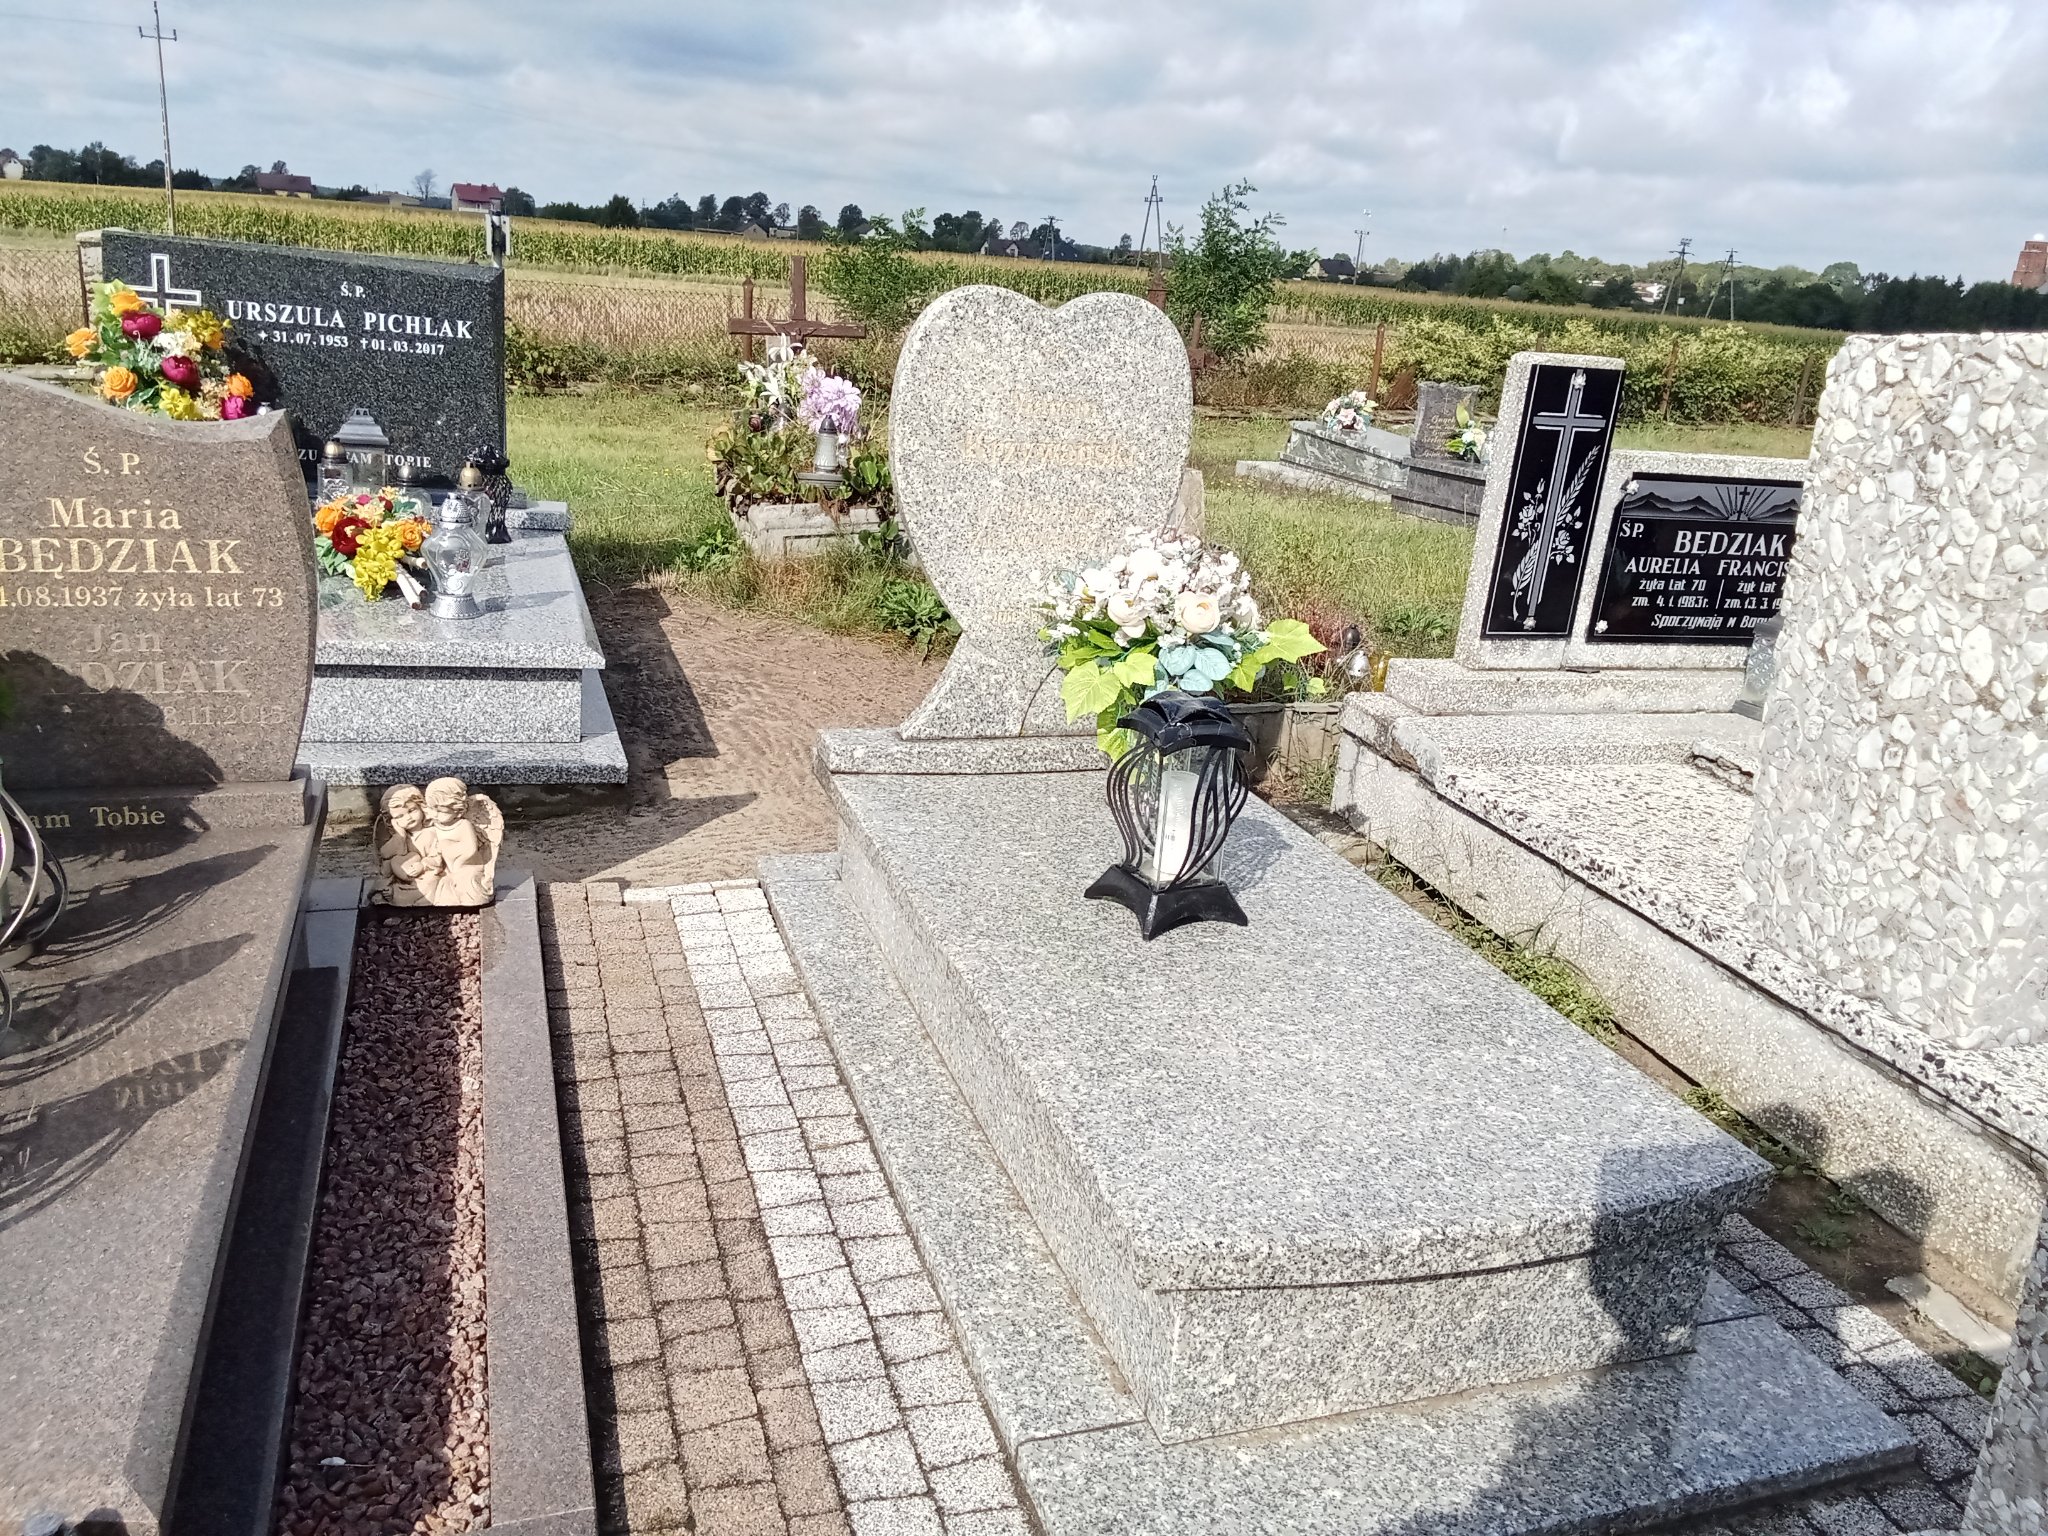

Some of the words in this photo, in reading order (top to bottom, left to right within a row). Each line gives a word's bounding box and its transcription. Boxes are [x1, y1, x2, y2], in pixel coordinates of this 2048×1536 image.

[227, 300, 346, 329] URSZULA
[363, 311, 474, 339] PICHLAK
[272, 330, 349, 347] 31.07.1953
[371, 340, 445, 355] 01.03.2017
[46, 497, 183, 530] Maria
[1673, 530, 1788, 557] BĘDZIAK
[0, 537, 245, 579] BĘDZIAK
[1624, 556, 1702, 575] AURELIA
[1638, 578, 1666, 592] żyła
[1668, 578, 1686, 591] lat
[1691, 579, 1707, 591] 70
[1736, 580, 1756, 594] żył
[1759, 581, 1777, 593] lat
[135, 586, 195, 612] żyła
[204, 586, 243, 608] lat
[252, 586, 284, 608] 73
[1631, 596, 1650, 607] zm.
[86, 623, 164, 653] Jan
[50, 659, 252, 697] DZIAK
[89, 805, 166, 827] Tobie
